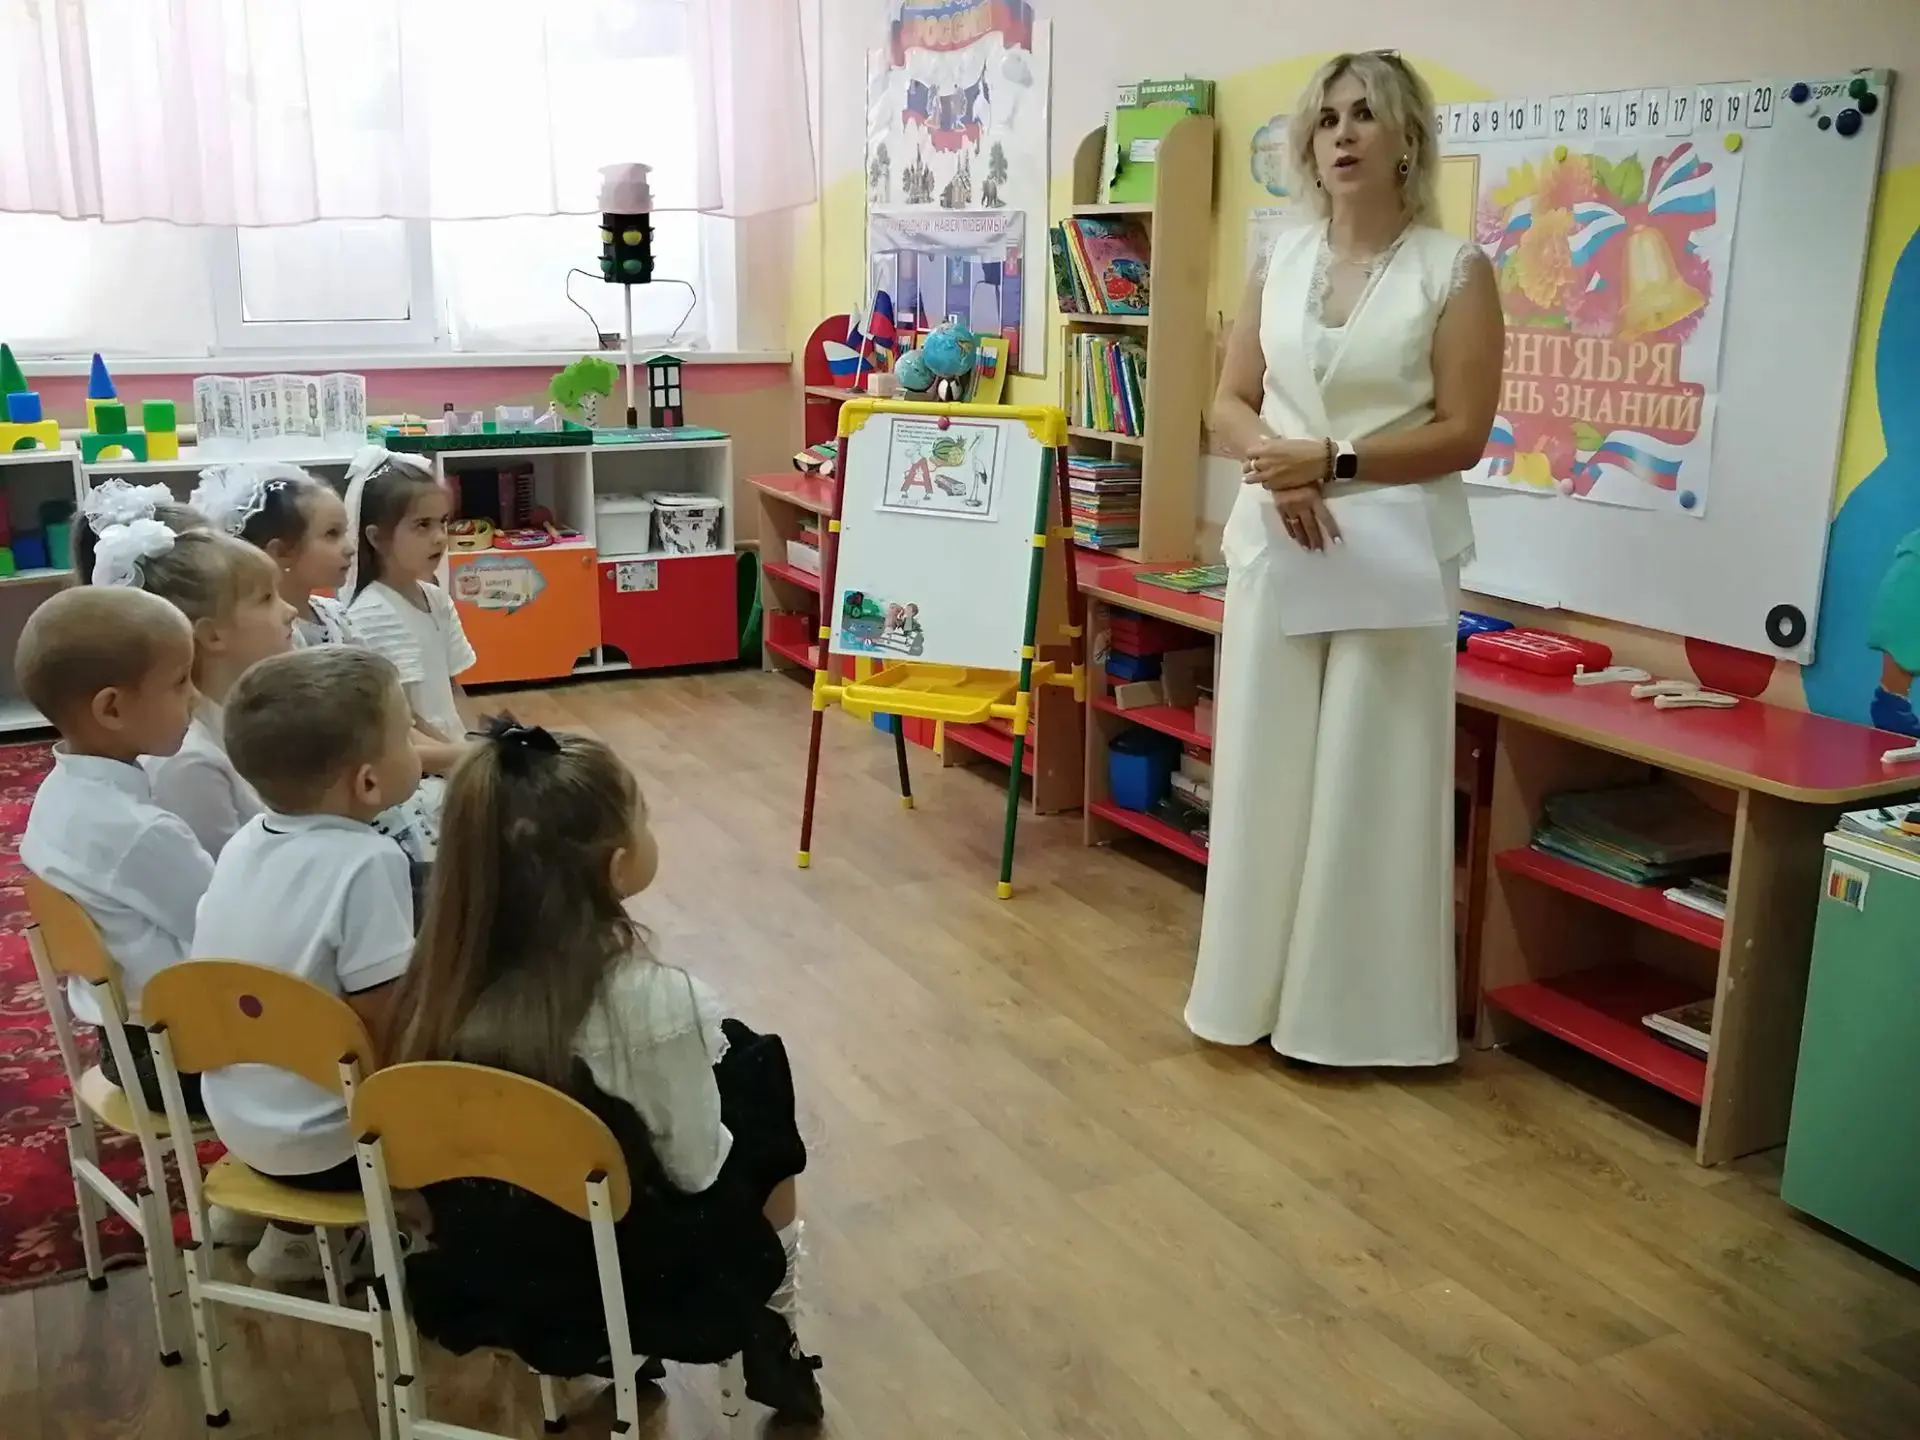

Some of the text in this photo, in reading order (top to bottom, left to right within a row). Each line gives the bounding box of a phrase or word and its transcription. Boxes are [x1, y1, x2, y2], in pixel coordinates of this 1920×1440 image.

[1436, 86, 1772, 135] 6 7 8 9 10 11 12 13 14 15 16 17 18 19 20
[1502, 332, 1678, 388] ЕНТЯБРЯ
[1552, 382, 1700, 432] ЗНАНИЙ
